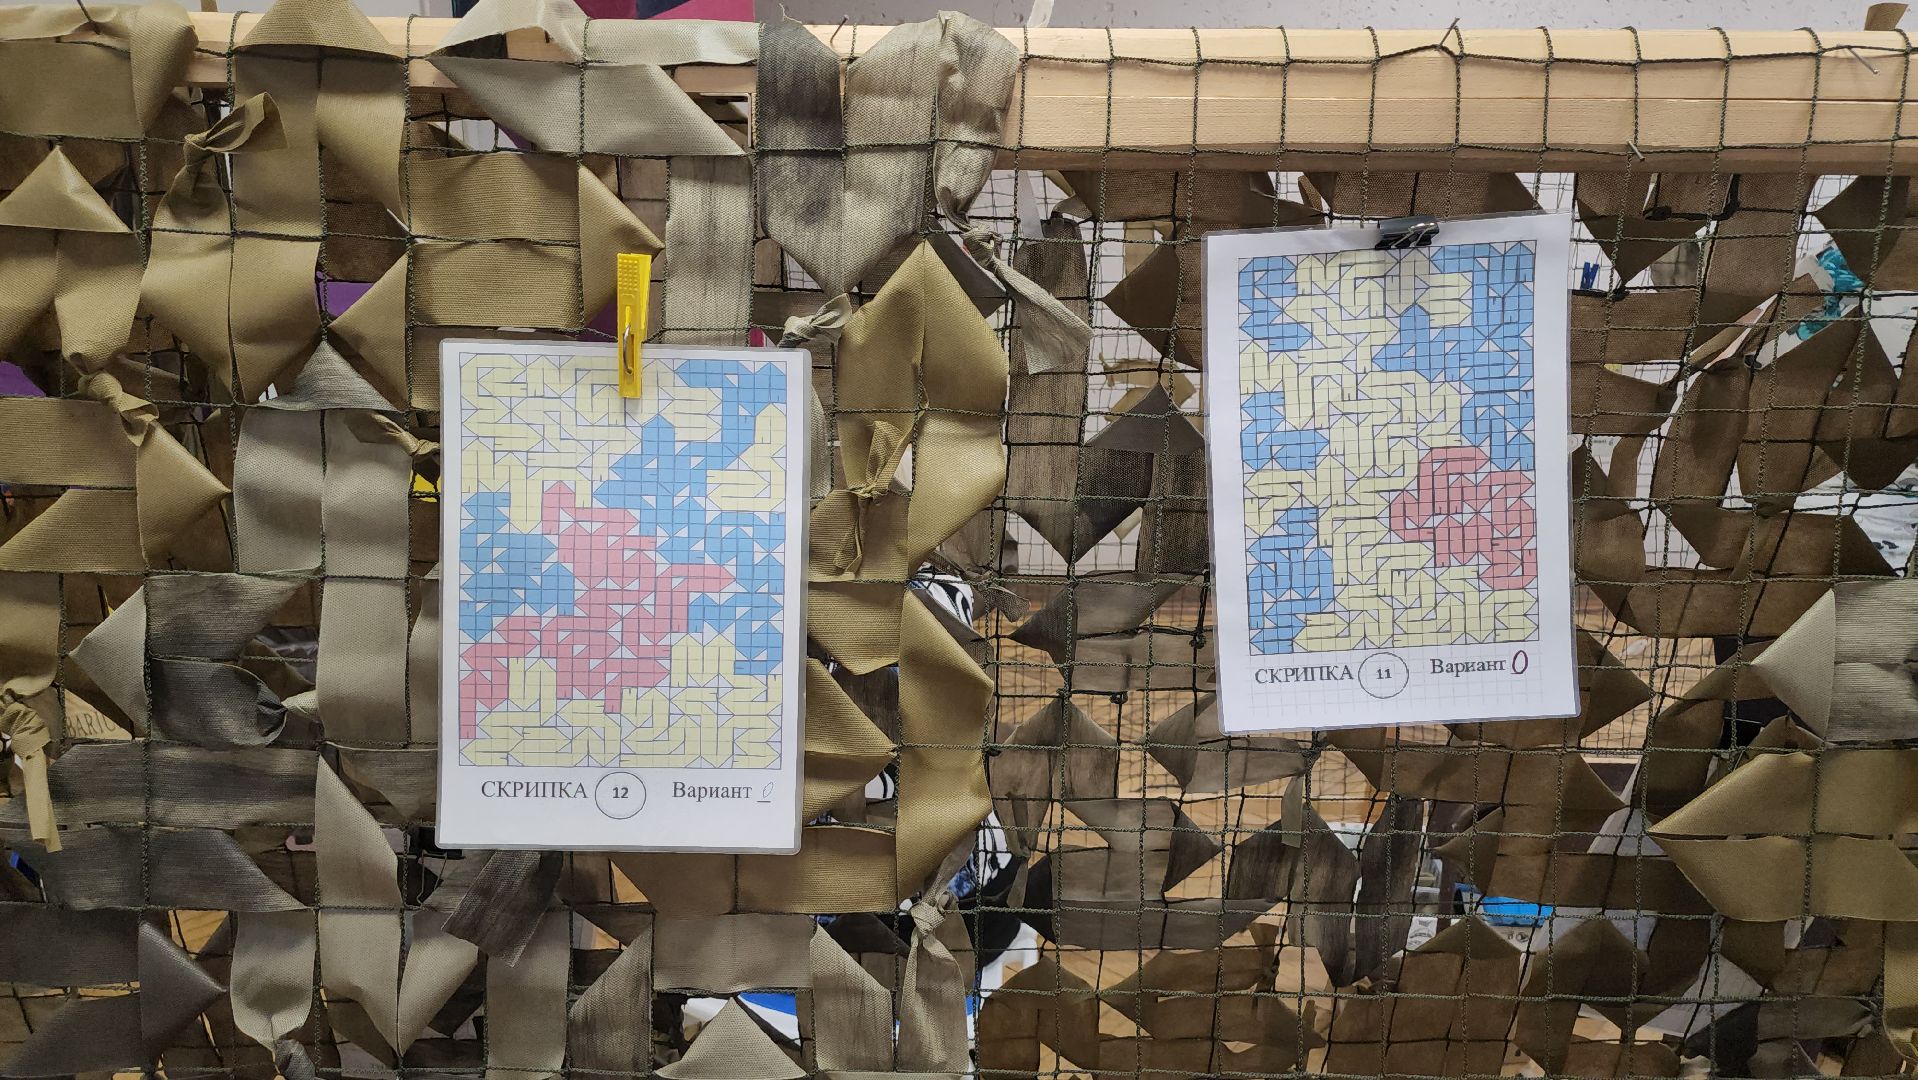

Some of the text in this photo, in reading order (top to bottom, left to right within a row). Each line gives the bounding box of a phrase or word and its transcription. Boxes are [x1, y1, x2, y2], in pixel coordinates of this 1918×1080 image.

[1255, 665, 1353, 684] СКРИПКА
[1376, 668, 1392, 680] 11
[1430, 656, 1507, 675] Вариант
[481, 780, 588, 799] СКРИПКА
[612, 786, 629, 799] 12
[672, 782, 753, 802] Вариант
